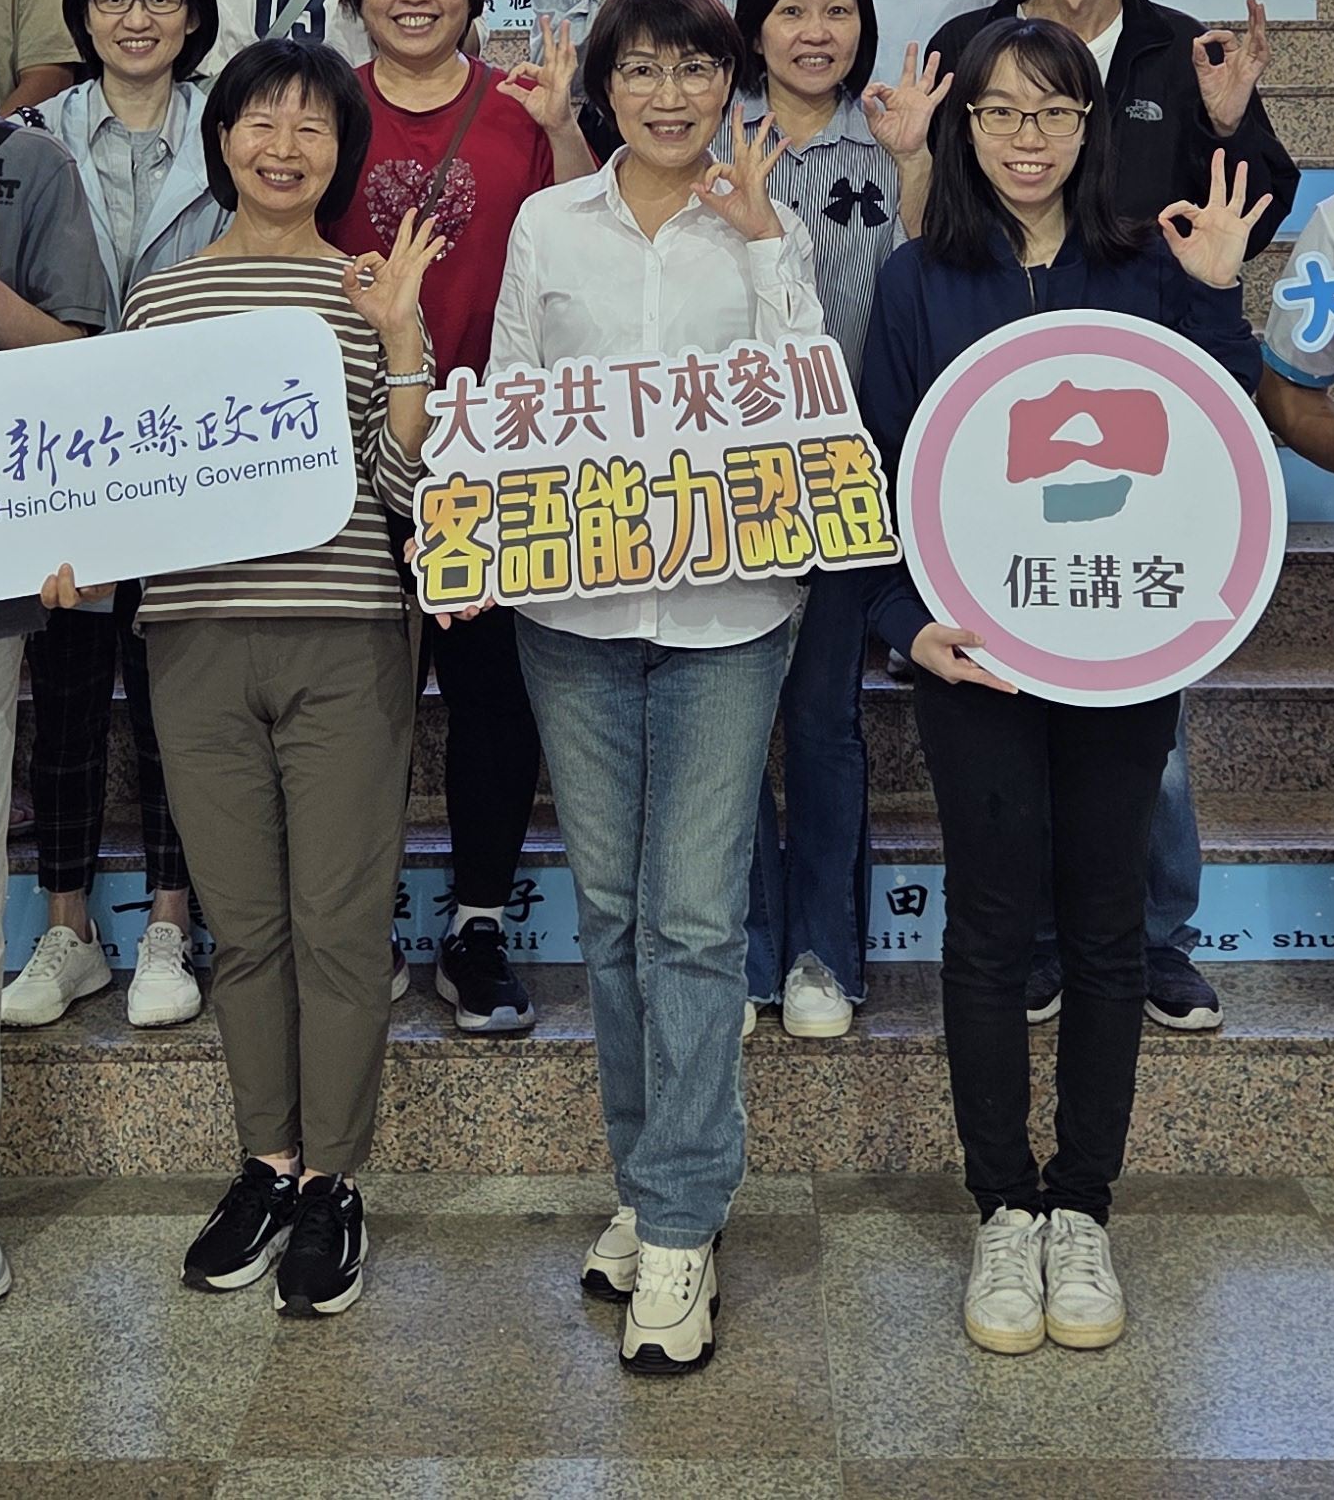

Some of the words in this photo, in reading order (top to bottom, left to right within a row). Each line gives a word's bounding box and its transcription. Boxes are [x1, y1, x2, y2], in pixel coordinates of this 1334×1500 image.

[1, 377, 320, 487] 新竹縣政府
[431, 343, 849, 459] 大家共下來參加
[105, 471, 189, 504] County
[196, 446, 340, 489] Government
[416, 432, 899, 604] 客語能力認證
